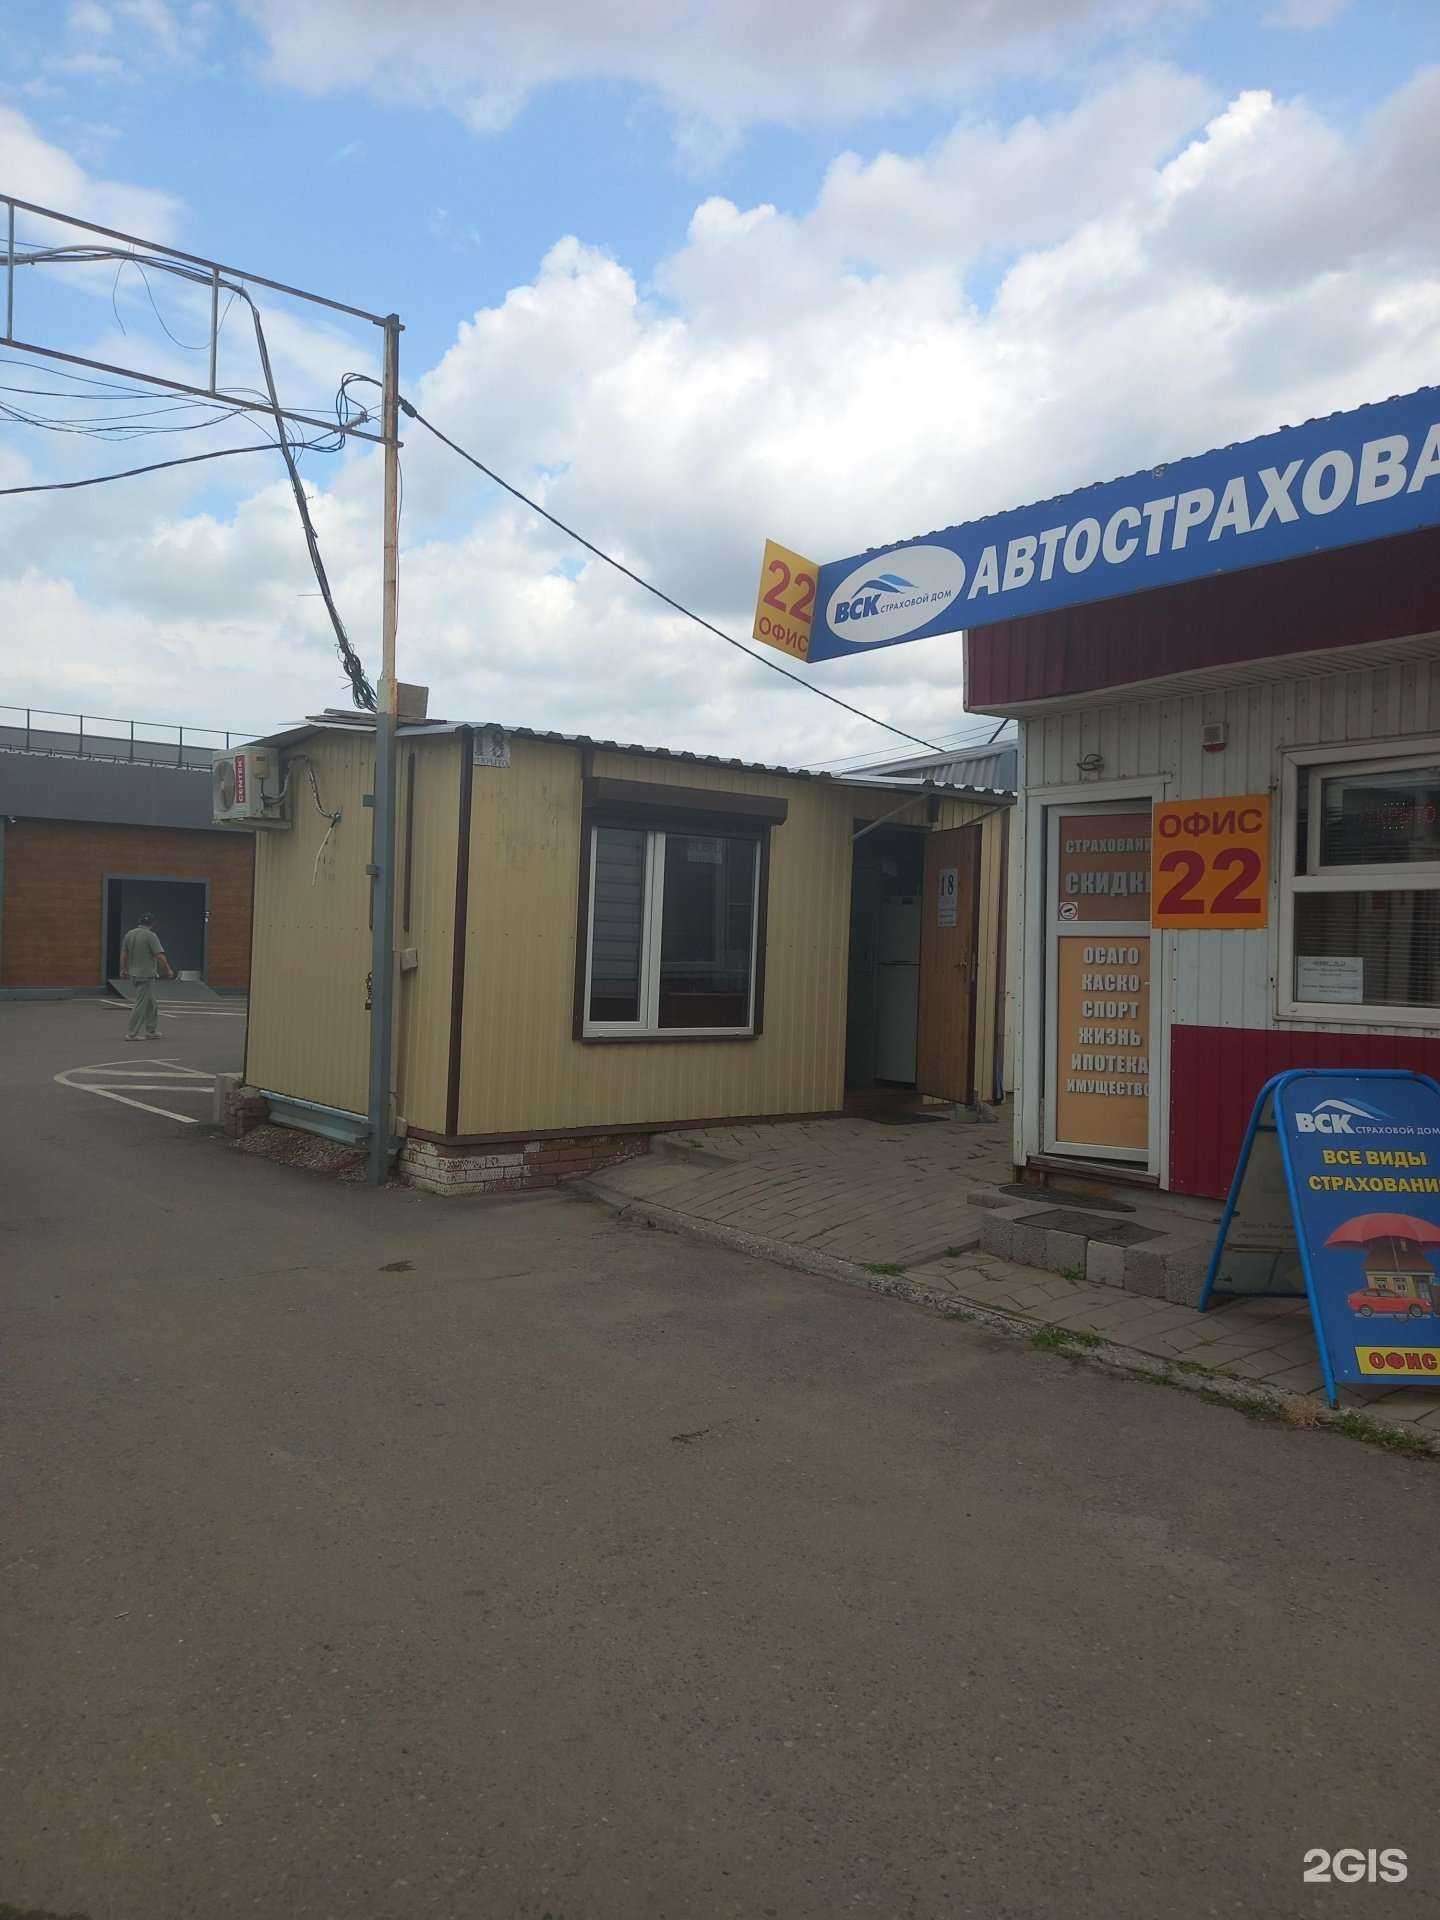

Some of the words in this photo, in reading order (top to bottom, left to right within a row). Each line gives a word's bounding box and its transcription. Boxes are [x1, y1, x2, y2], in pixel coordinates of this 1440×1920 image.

[763, 559, 816, 624] 22
[834, 592, 882, 624] ВСК
[880, 592, 929, 614] СТРАХОВОЙ
[930, 589, 953, 603] ДОМ
[758, 616, 808, 653] ОФИС
[1158, 807, 1263, 839] ОФИС
[939, 874, 955, 896] 18
[1157, 847, 1262, 915] 22
[1082, 947, 1140, 965] ОСАГО
[1081, 974, 1140, 992] КАСКО
[1081, 1000, 1139, 1019] СПОРТ
[1078, 1026, 1141, 1046] ЖИЗНЬ
[1071, 1053, 1149, 1074] ИПОТЕКА
[1295, 1113, 1356, 1134] ВСК
[1355, 1125, 1415, 1135] СТРАХОВОЙ
[1322, 1149, 1362, 1166] ВСЕ
[1366, 1150, 1427, 1168] ВИДЫ
[1308, 1175, 1440, 1193] СТРАХОВАНИ
[1369, 1352, 1438, 1370] ОФИС
